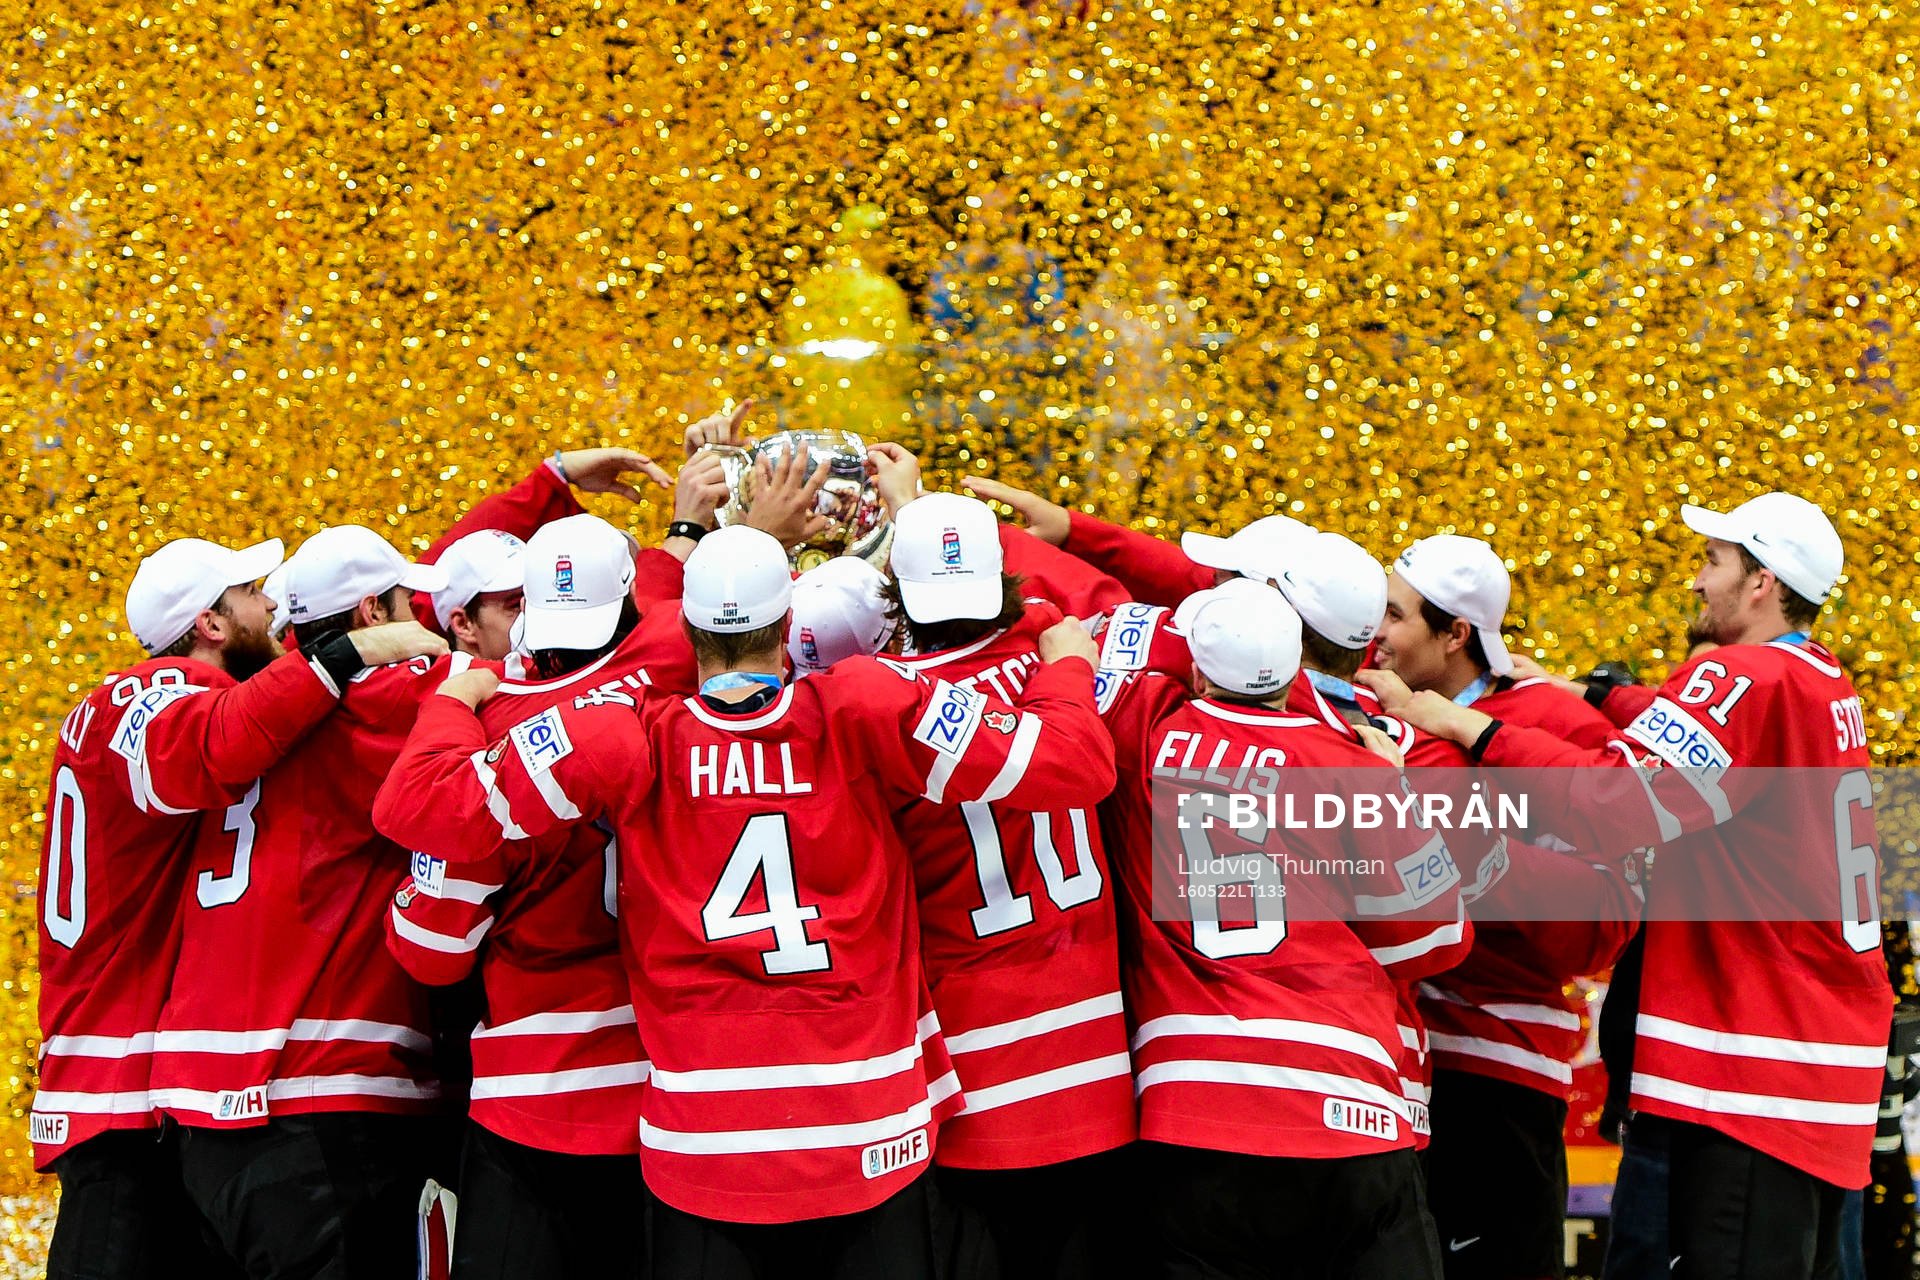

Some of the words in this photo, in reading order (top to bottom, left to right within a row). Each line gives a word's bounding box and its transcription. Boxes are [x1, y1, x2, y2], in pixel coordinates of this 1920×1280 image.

[713, 616, 750, 625] CHAMPIONS
[1678, 659, 1753, 728] 61
[689, 741, 813, 798] HALL
[1151, 729, 1288, 797] ELLIS
[701, 811, 833, 977] 4
[1176, 790, 1289, 961] 6
[37, 1118, 64, 1141] IIHF
[1346, 1105, 1392, 1135] IIHF
[882, 1134, 923, 1171] IIHF
